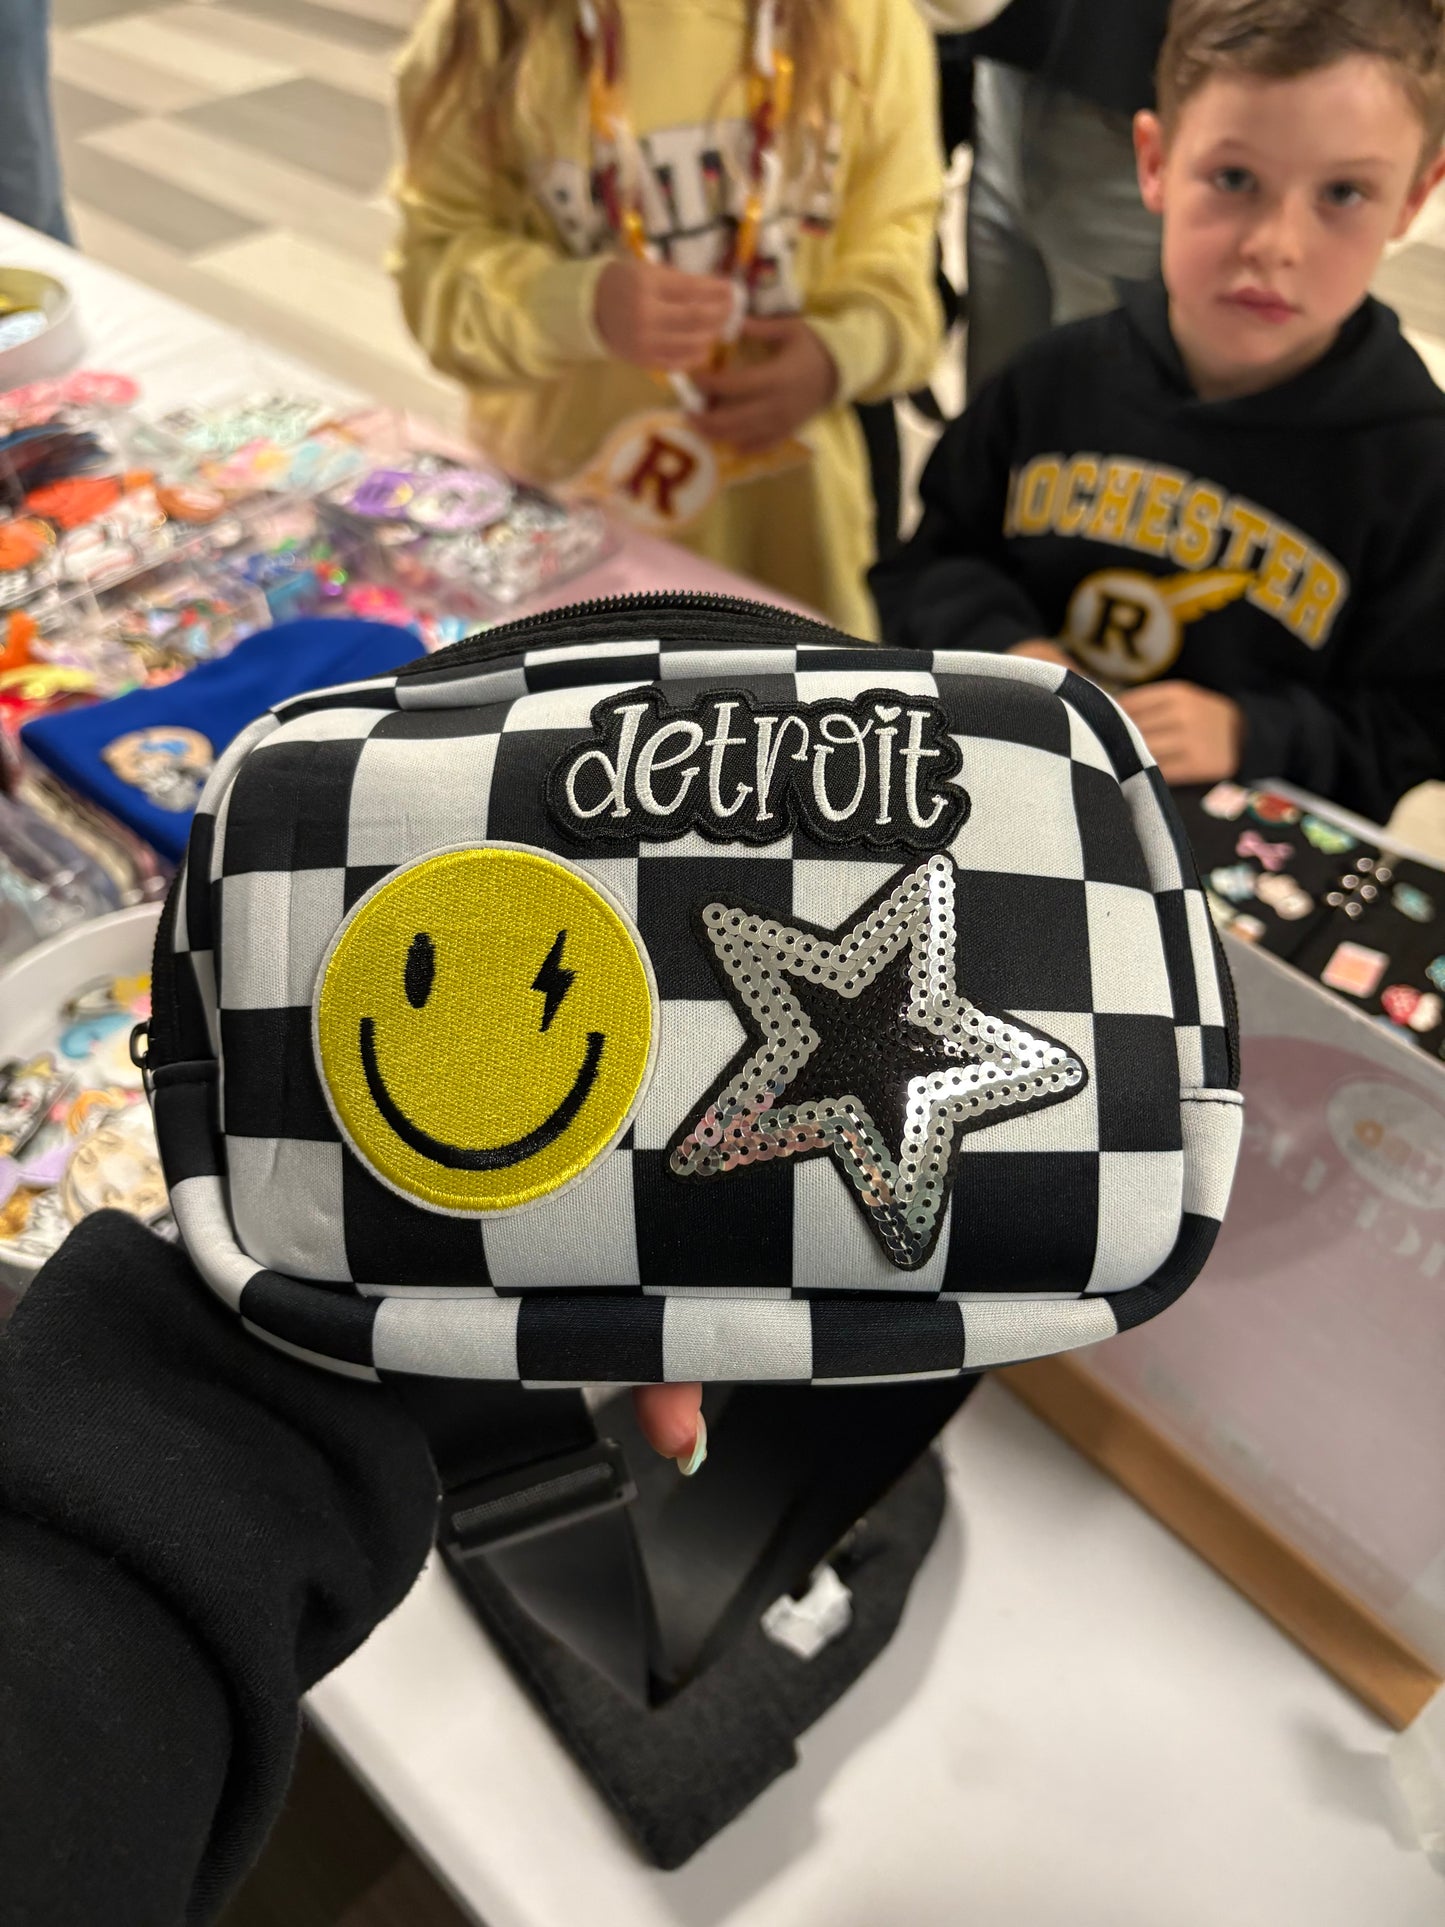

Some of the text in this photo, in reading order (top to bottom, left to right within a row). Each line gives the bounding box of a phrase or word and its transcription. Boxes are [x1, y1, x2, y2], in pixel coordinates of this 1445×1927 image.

[621, 433, 697, 520] R
[1003, 453, 1349, 649] OCHESTER
[1089, 593, 1149, 660] R
[565, 702, 949, 828] detroit
